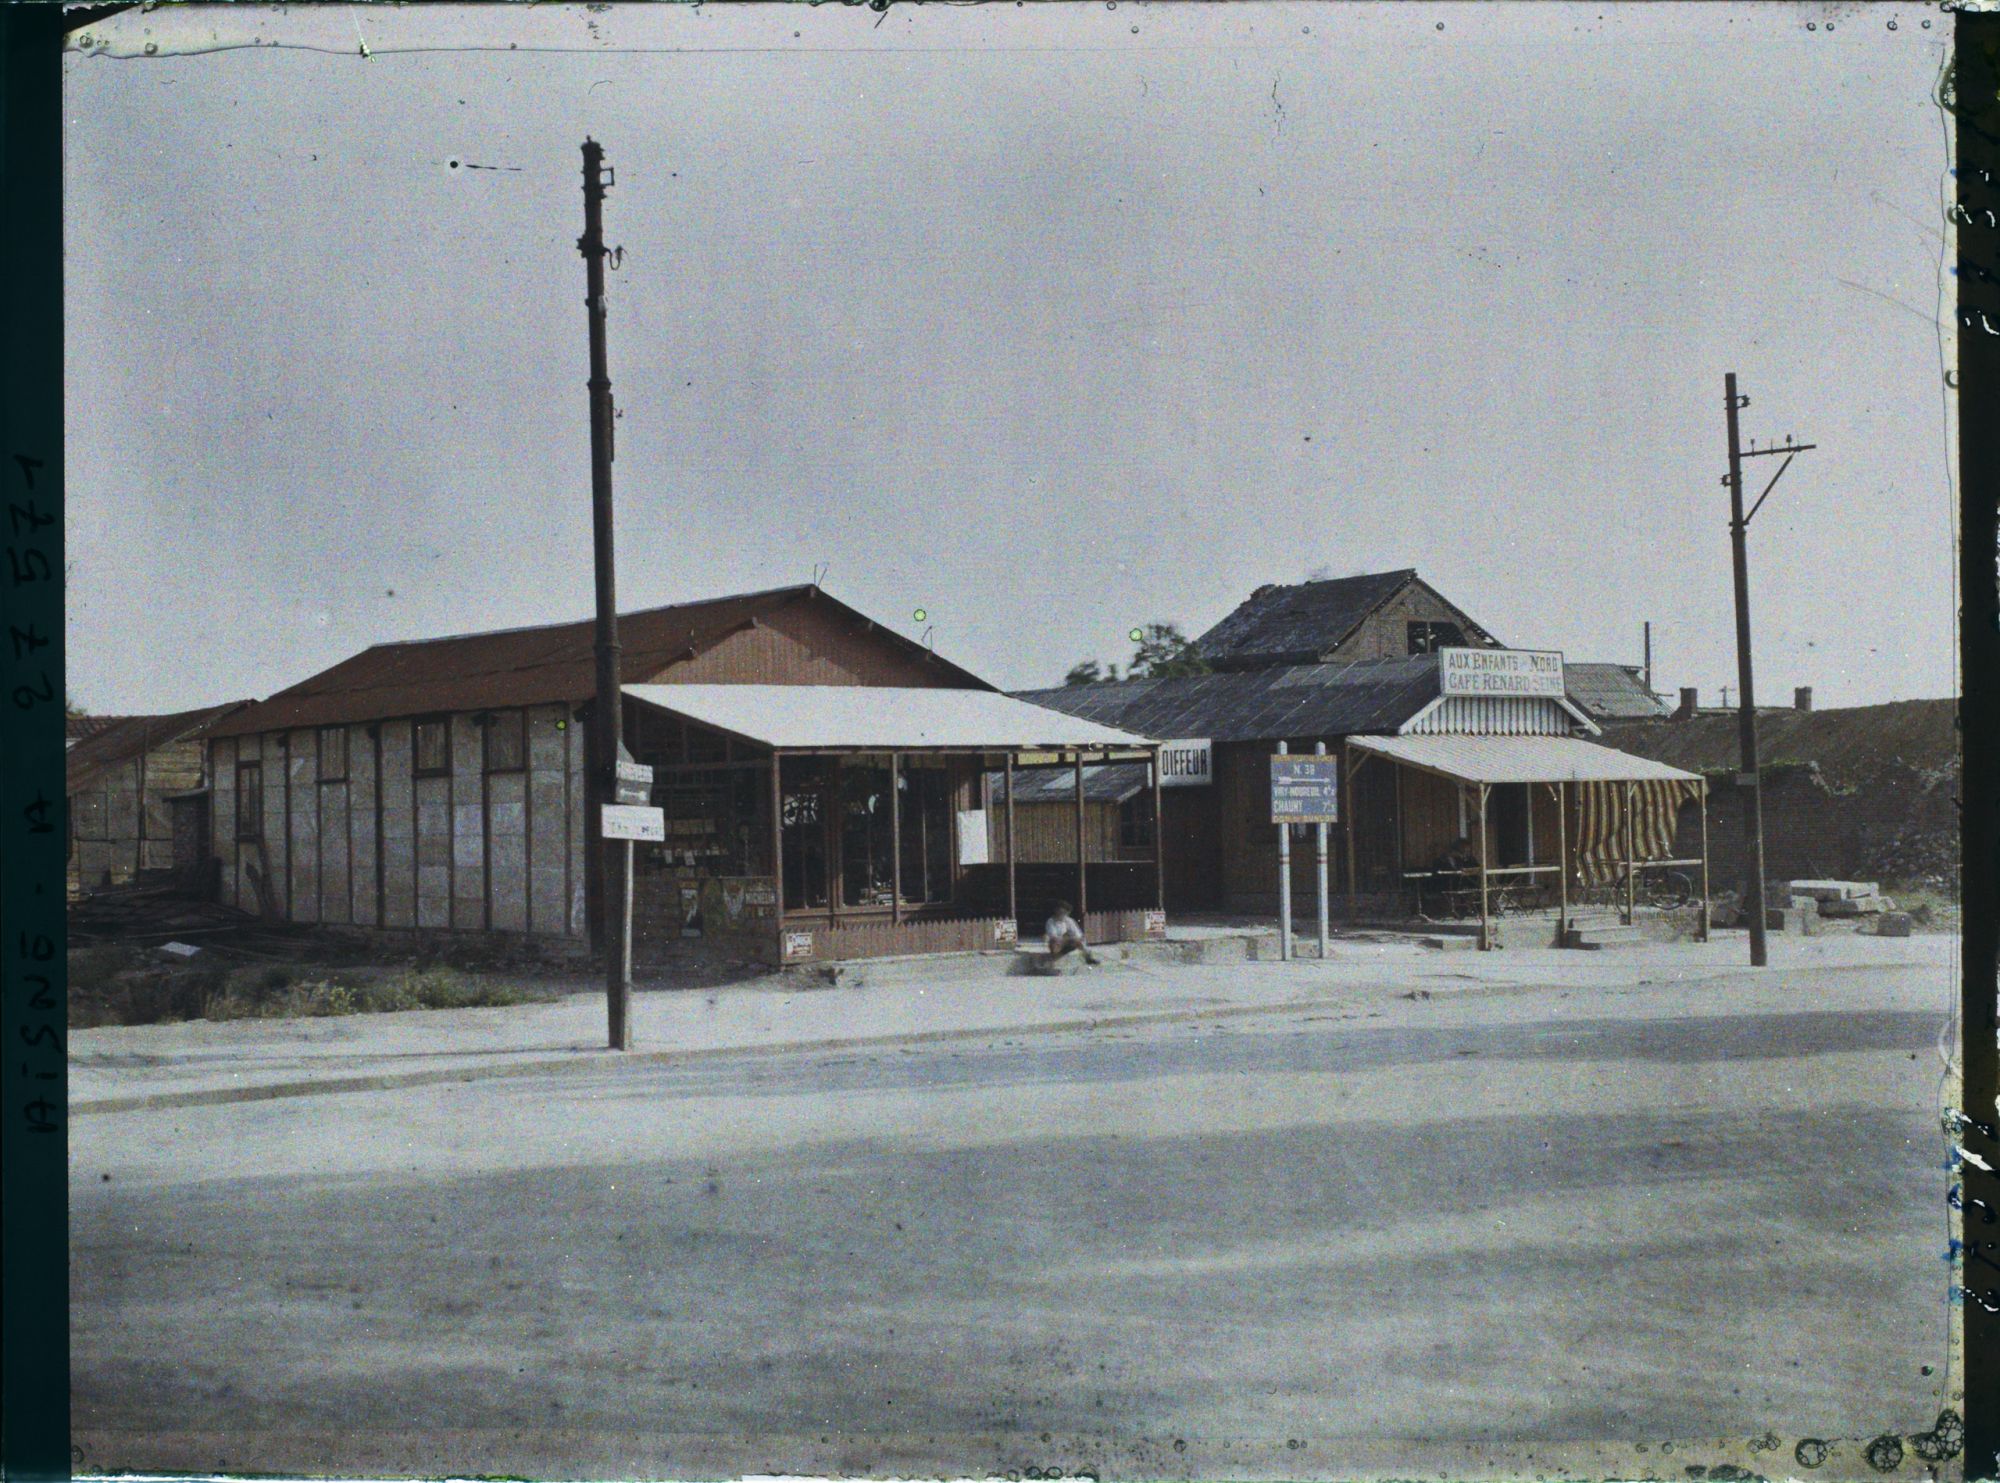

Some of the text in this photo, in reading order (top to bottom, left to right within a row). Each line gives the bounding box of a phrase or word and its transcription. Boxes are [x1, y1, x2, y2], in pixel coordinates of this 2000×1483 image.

[1449, 652, 1470, 669] AUX
[1472, 652, 1519, 671] ENFANTS
[1529, 654, 1558, 672] NORD
[1482, 672, 1529, 691] RENARD
[1162, 749, 1208, 776] OIFFEUR
[1274, 800, 1303, 812] CHAUNY
